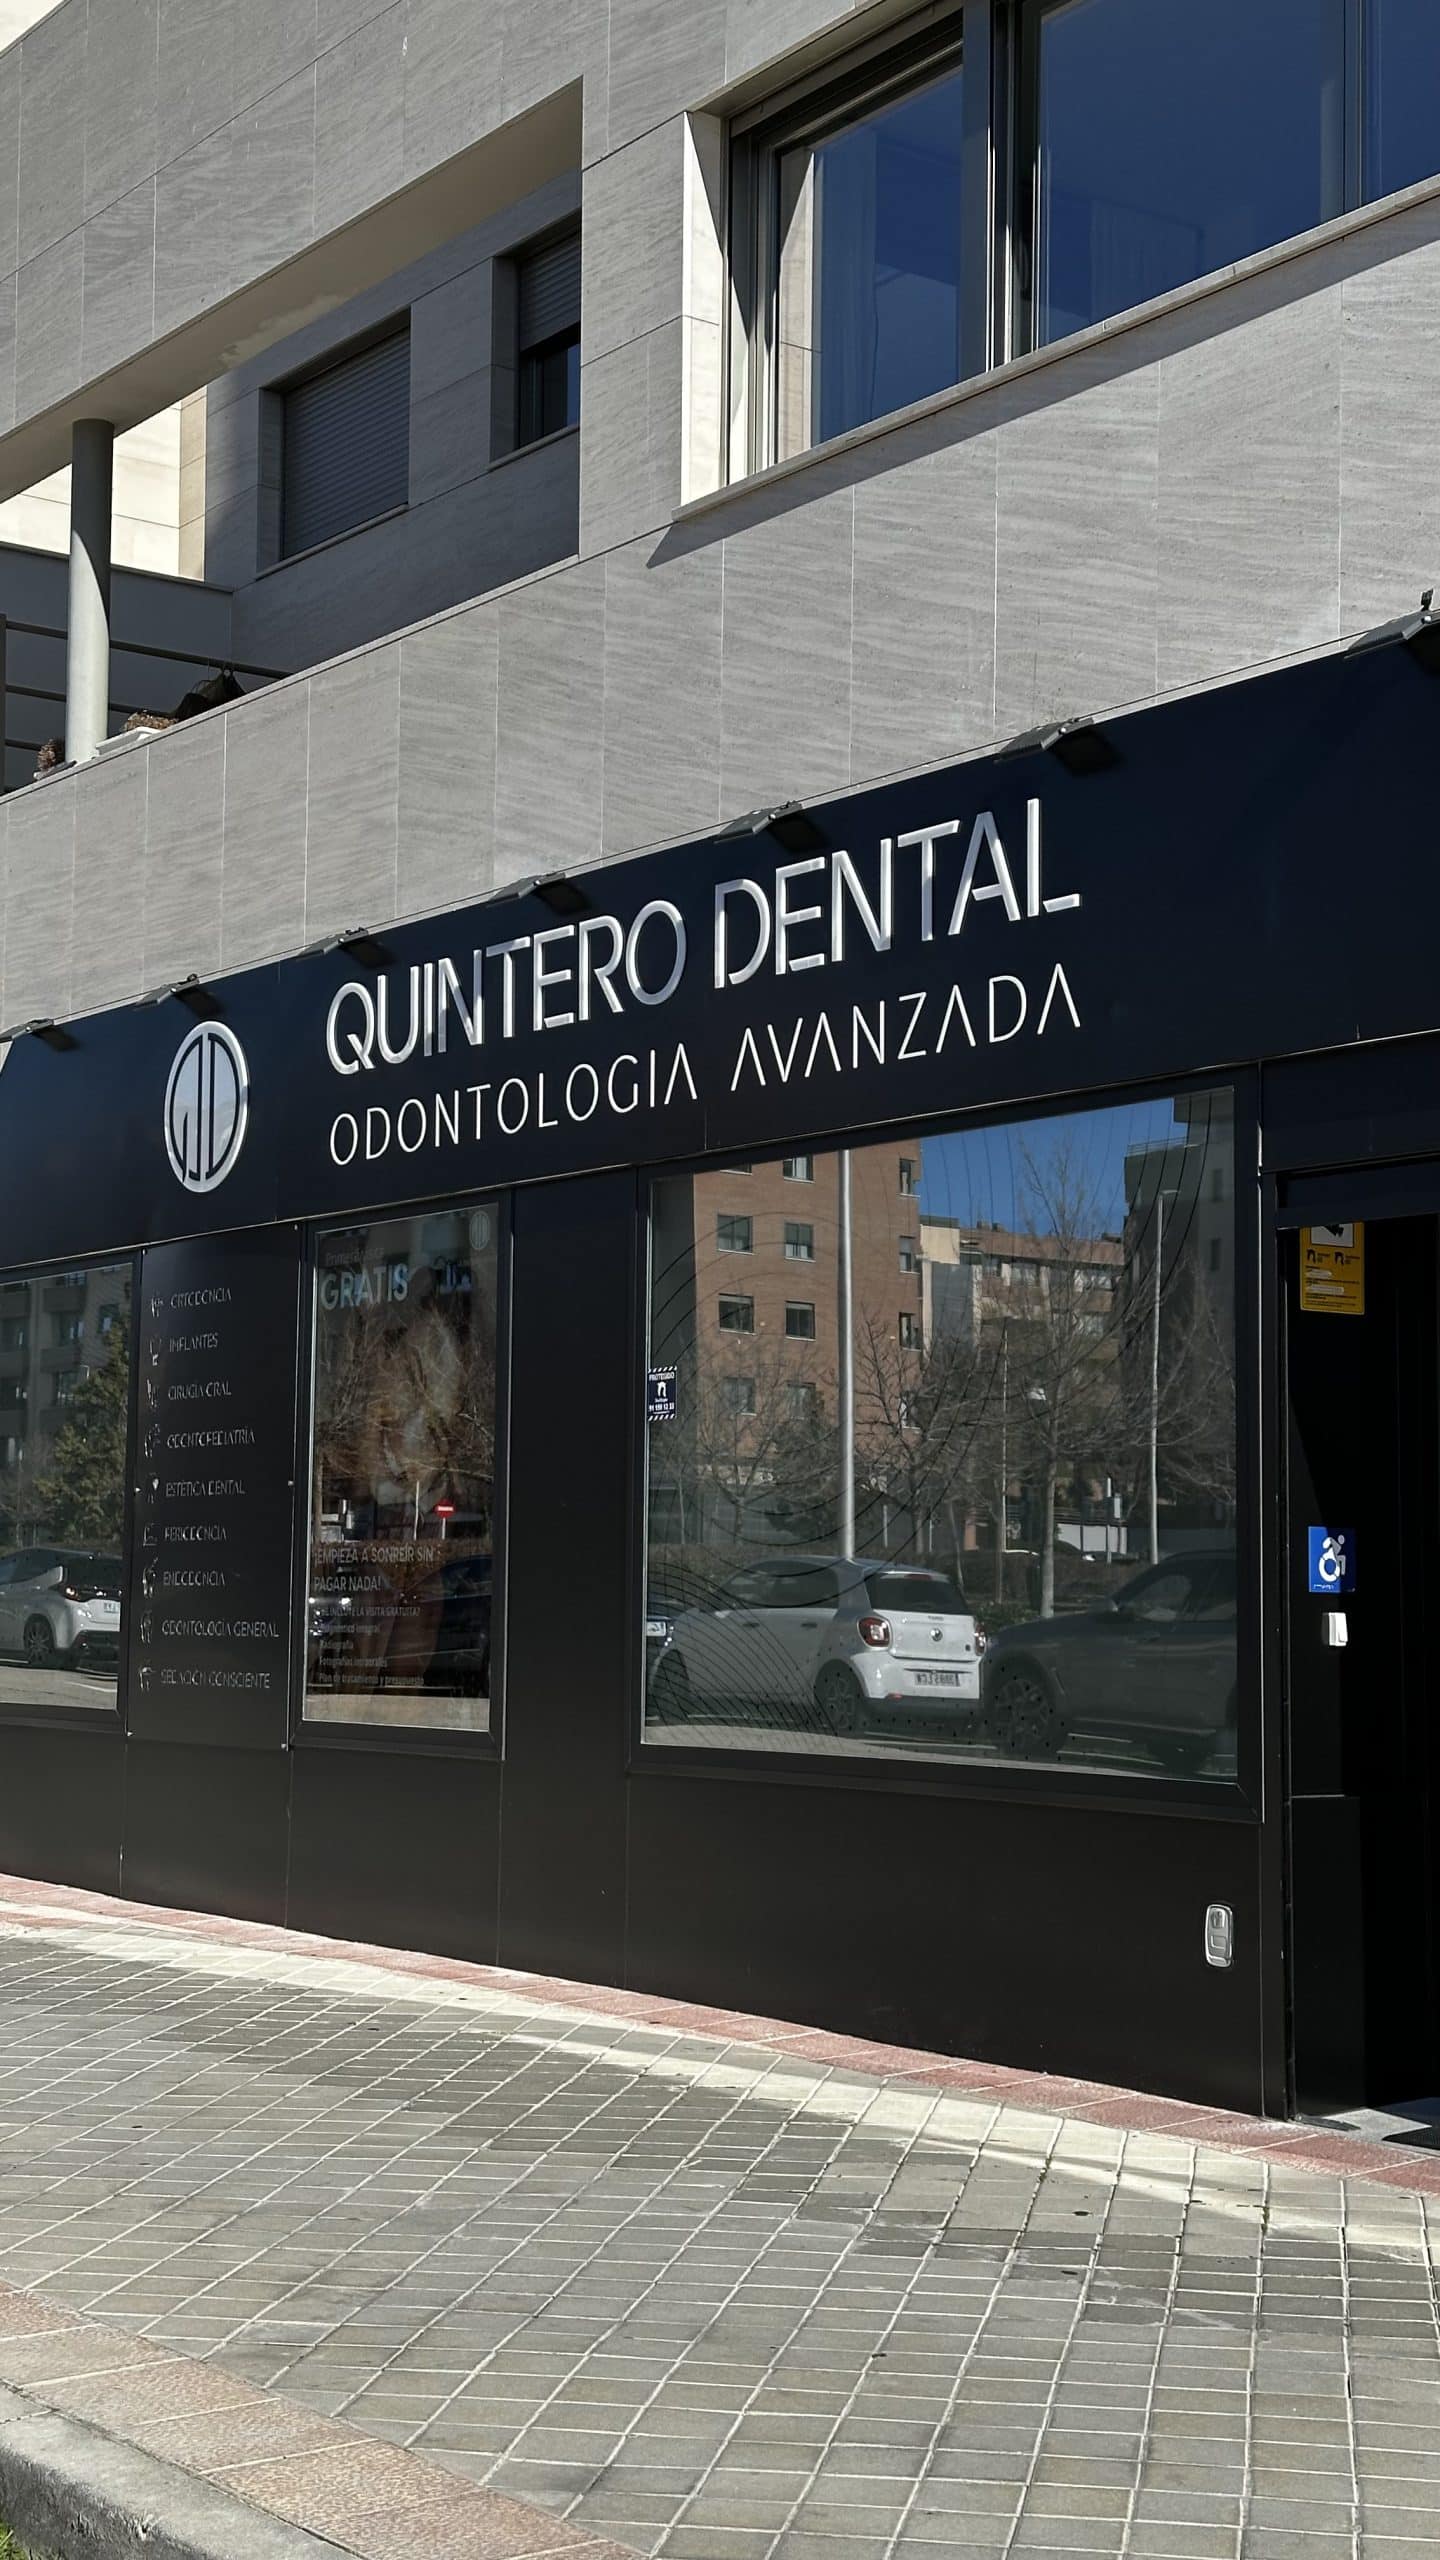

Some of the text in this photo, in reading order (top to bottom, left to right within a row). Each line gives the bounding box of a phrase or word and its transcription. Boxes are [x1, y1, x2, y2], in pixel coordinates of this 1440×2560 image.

[326, 796, 1082, 1076] QUINTERO DENTAL
[328, 962, 1082, 1166] ODONTOLOGIA AVANZADA
[320, 1263, 409, 1311] GRATIS
[170, 1287, 233, 1309] ORTODONCIA
[169, 1331, 219, 1353] IMPLANTES
[205, 1380, 232, 1398] ORAL
[208, 1479, 246, 1496] DENTAL
[361, 1548, 369, 1562] A
[416, 1547, 434, 1563] SIN
[313, 1576, 382, 1592] PAGAR NADA!
[233, 1620, 281, 1638] GENERAL
[208, 1670, 272, 1689] CONSCIENTE
